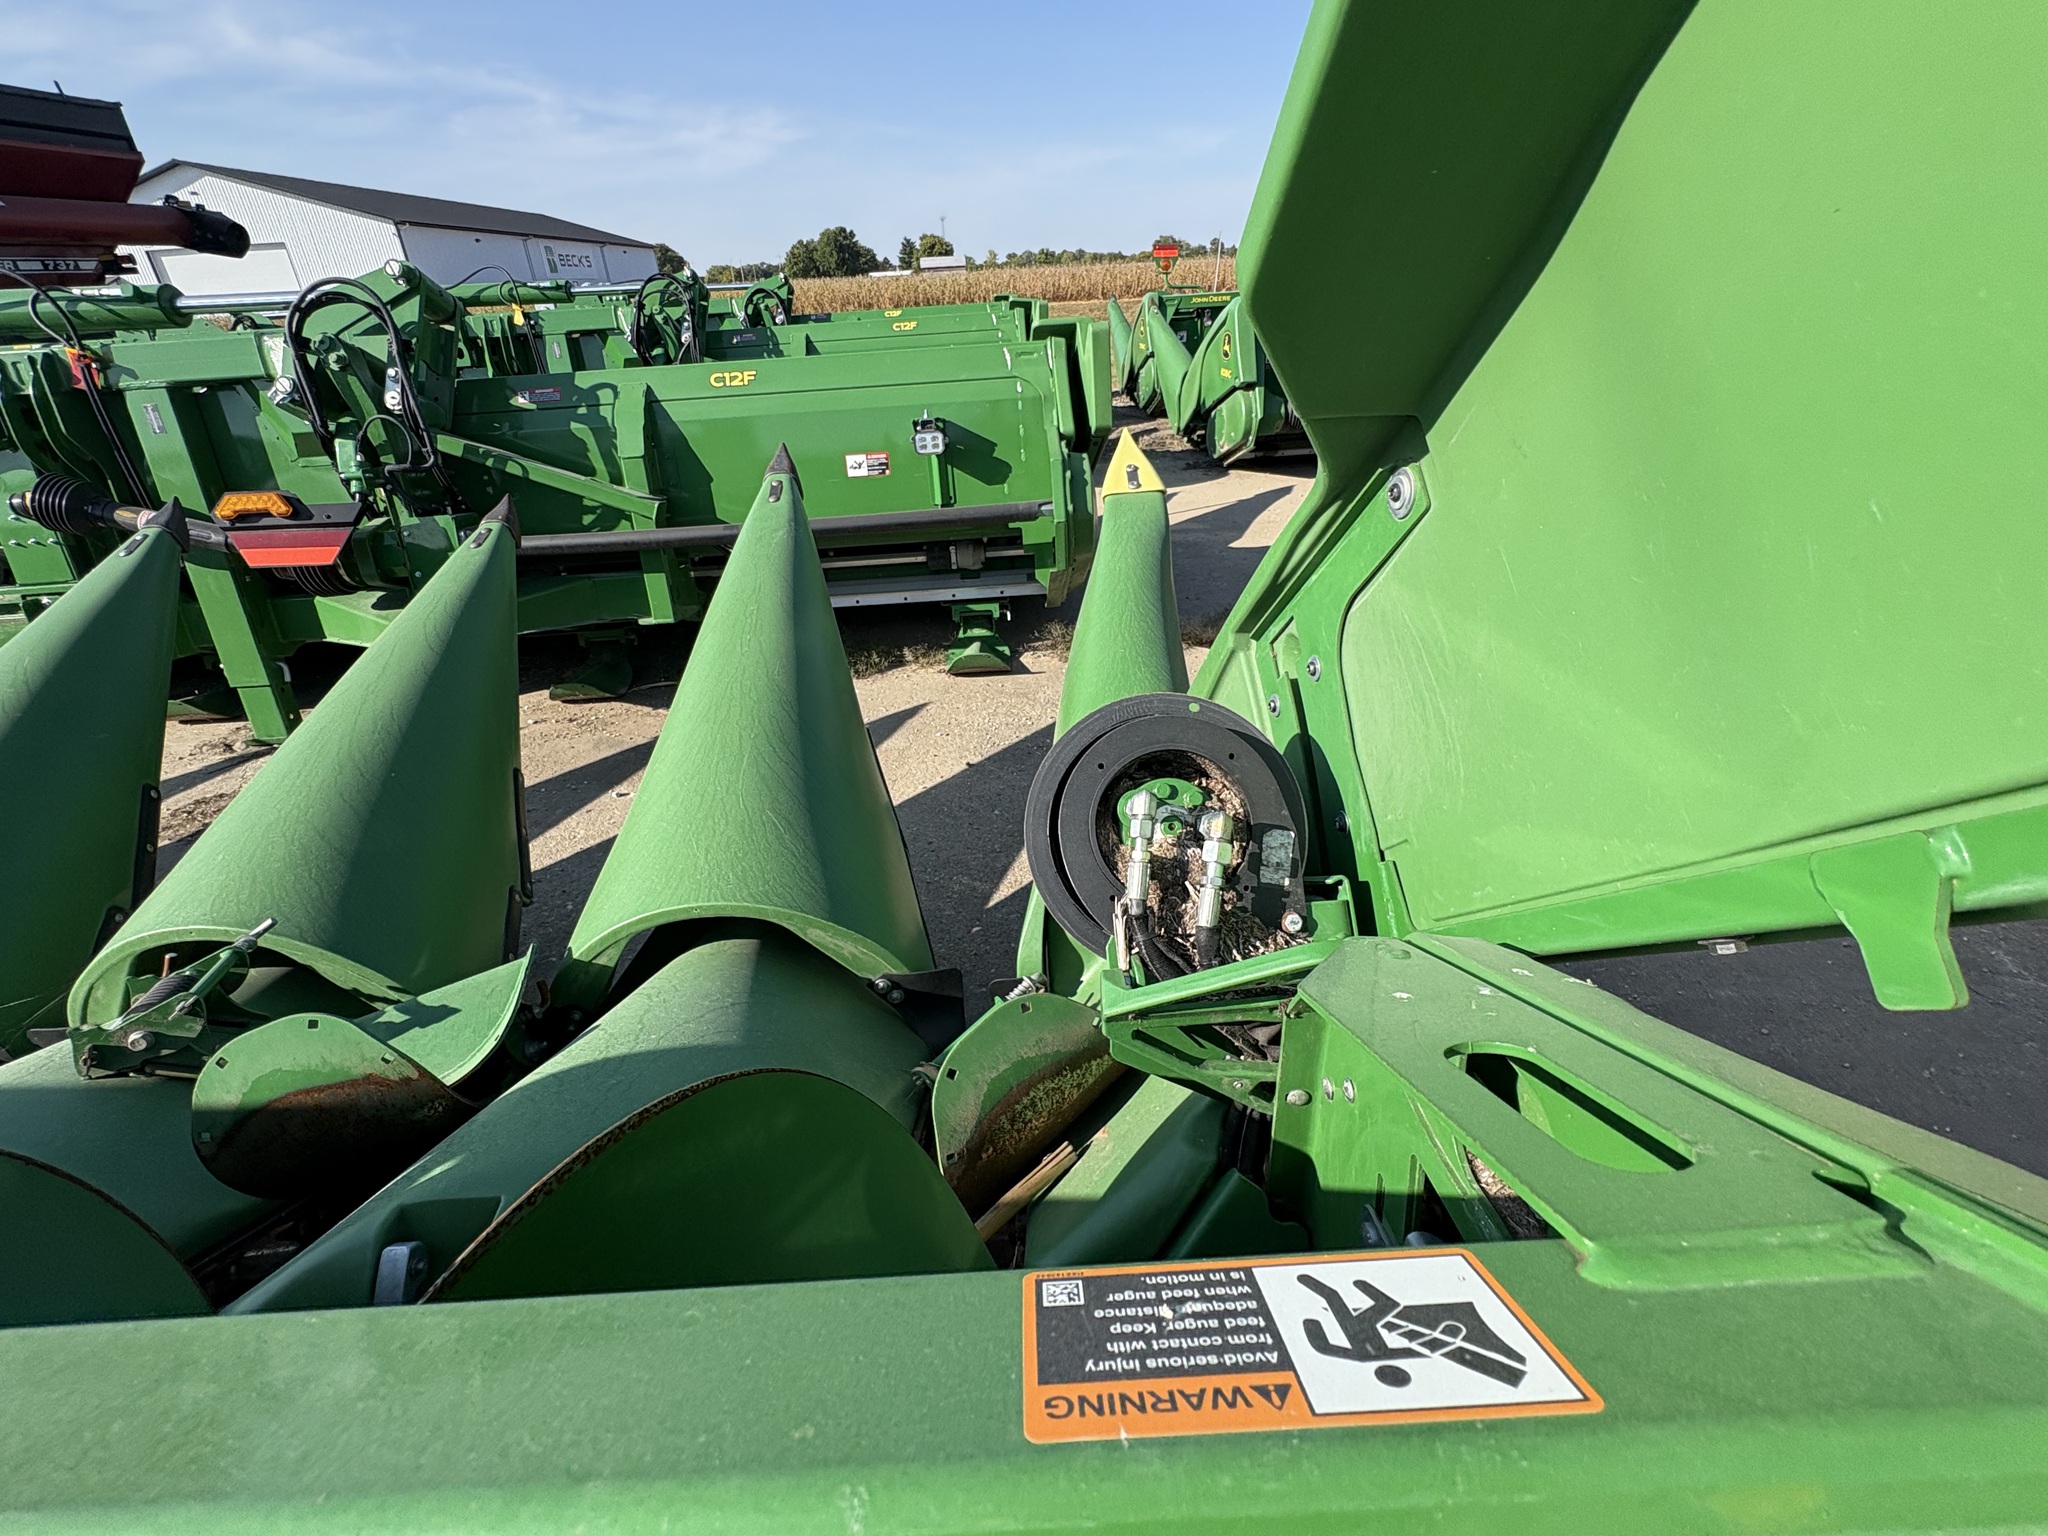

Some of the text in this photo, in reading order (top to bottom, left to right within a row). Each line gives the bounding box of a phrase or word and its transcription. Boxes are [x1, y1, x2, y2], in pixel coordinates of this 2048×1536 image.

[44, 260, 77, 271] 737
[557, 253, 593, 268] BECK'S
[1190, 295, 1232, 304] JOHN DEERE
[884, 310, 903, 318] C12F
[892, 321, 918, 331] C12F
[709, 370, 757, 388] C12F
[1140, 1270, 1246, 1285] is in motion.
[1106, 1285, 1252, 1302] when feed auger
[1093, 1305, 1171, 1319] istance
[1109, 1315, 1266, 1334] feed auger. Keep
[1106, 1333, 1274, 1354] from contact with
[1085, 1350, 1278, 1373] Avoid serious injury
[1044, 1385, 1255, 1420] WARNING
